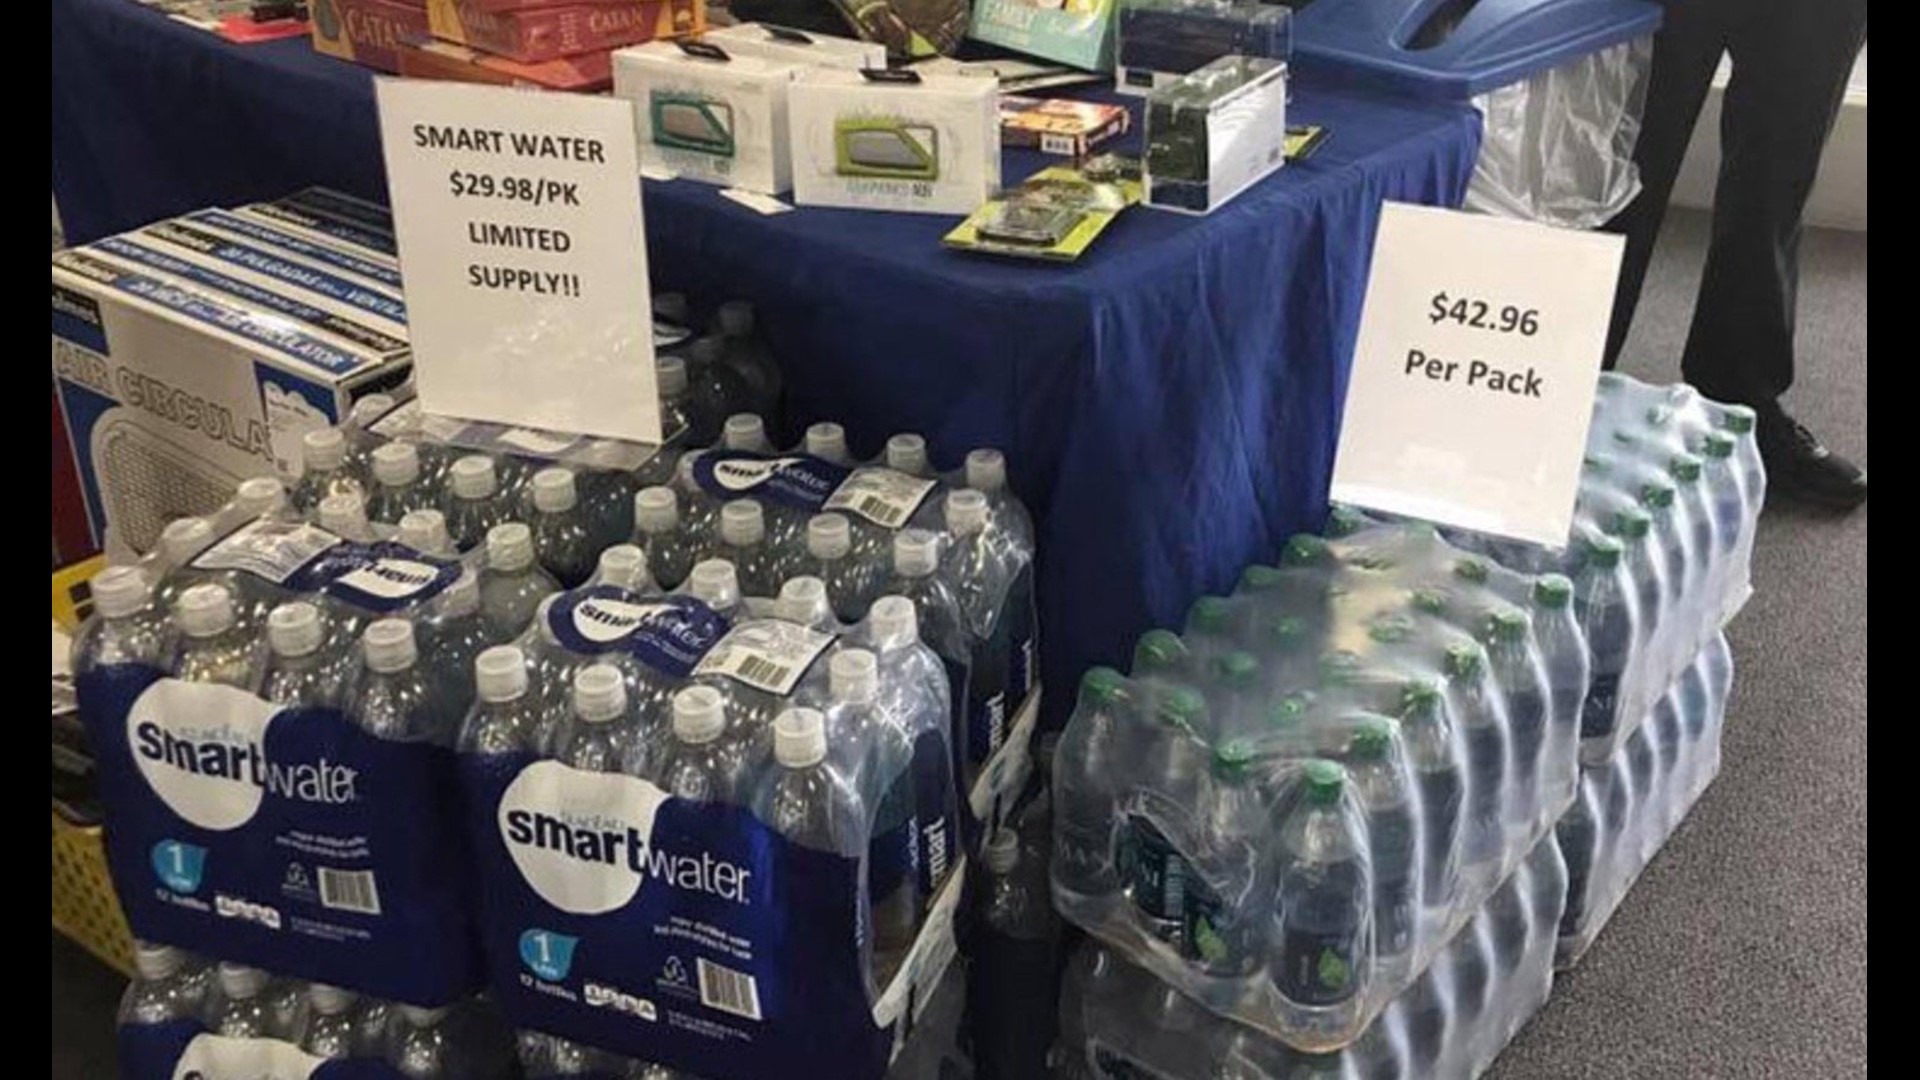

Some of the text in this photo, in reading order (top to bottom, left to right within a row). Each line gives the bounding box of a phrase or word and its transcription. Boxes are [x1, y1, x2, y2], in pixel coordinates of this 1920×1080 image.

[413, 124, 605, 164] SMART WATER
[449, 169, 580, 206] $29.98/PK
[468, 221, 571, 253] LIMITED
[468, 264, 580, 298] SUPPLY!!
[1428, 291, 1540, 336] $42.96
[1405, 349, 1543, 398] Per Pack
[533, 934, 550, 962] 1
